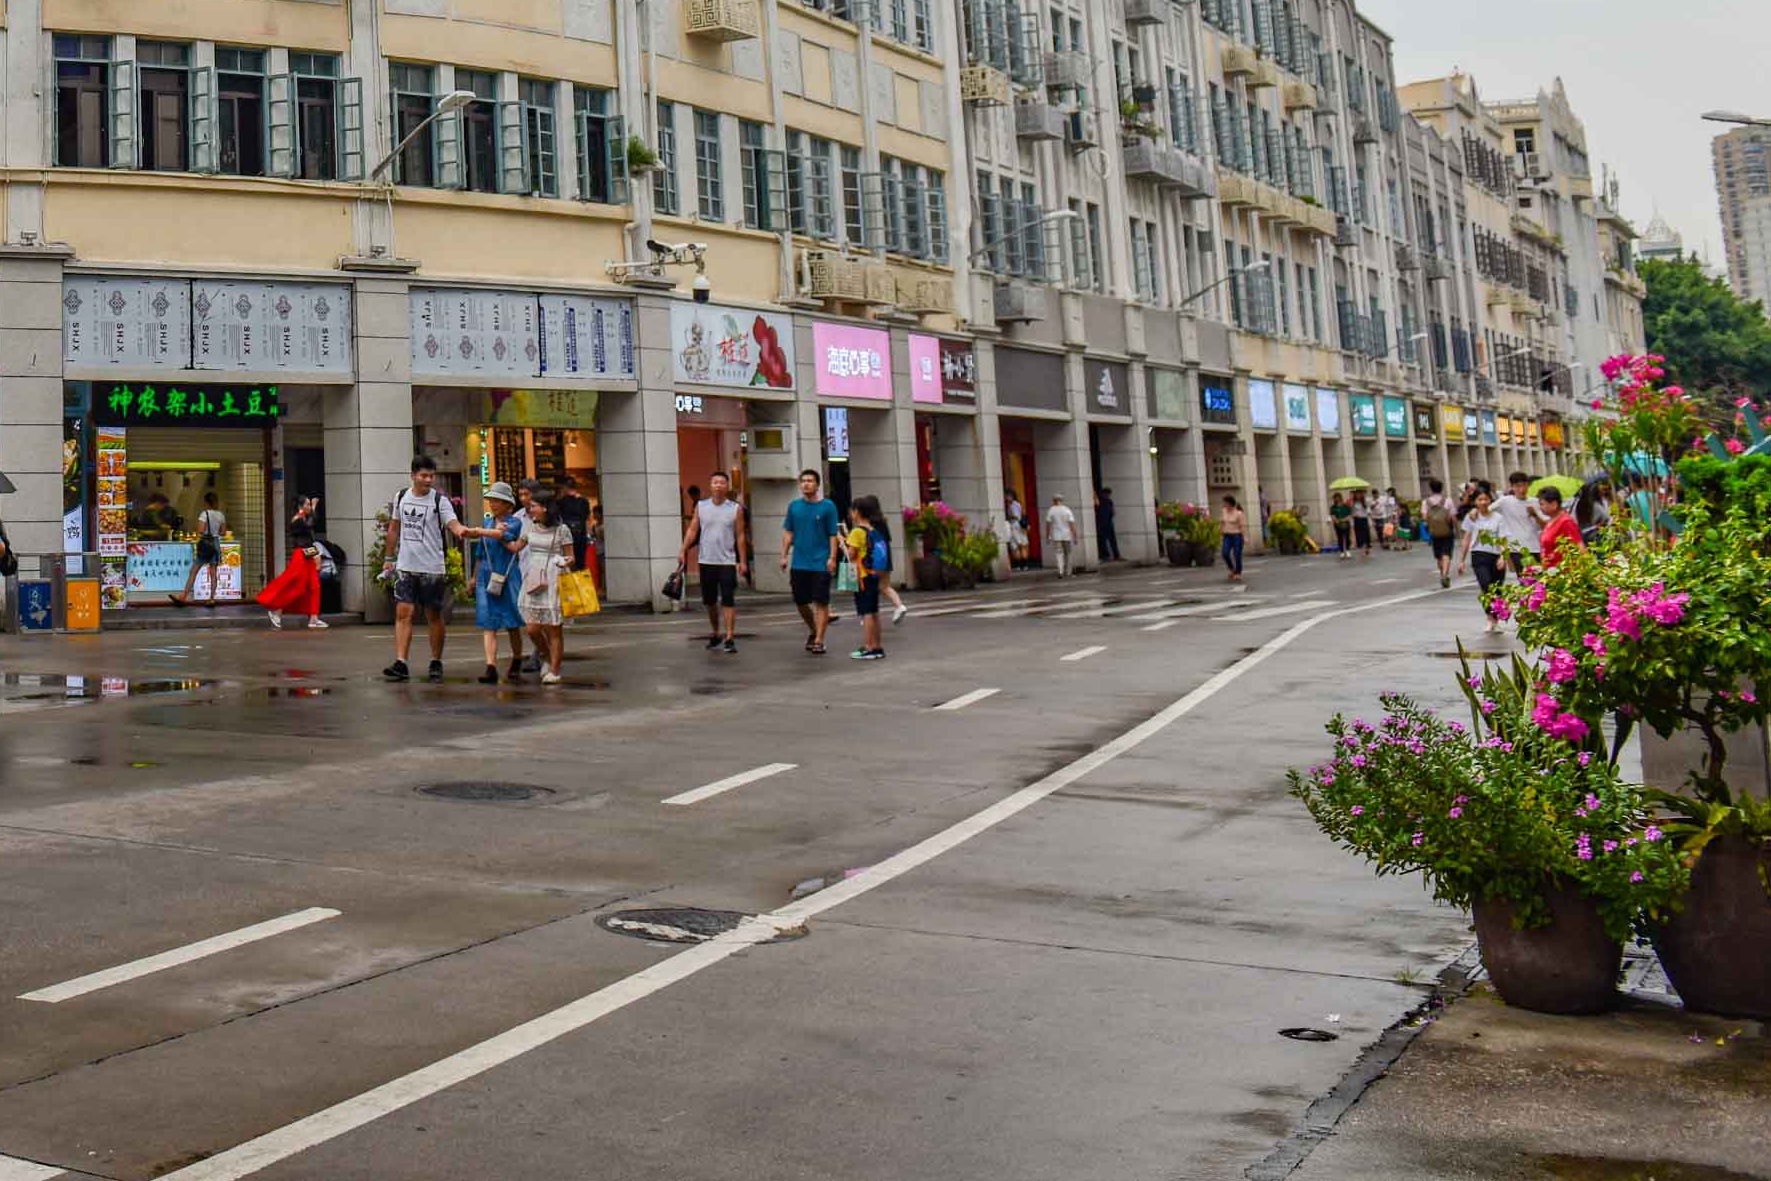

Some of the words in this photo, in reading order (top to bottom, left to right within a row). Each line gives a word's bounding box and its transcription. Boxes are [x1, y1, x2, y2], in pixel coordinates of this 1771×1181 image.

[108, 384, 267, 418] 神农架小土豆
